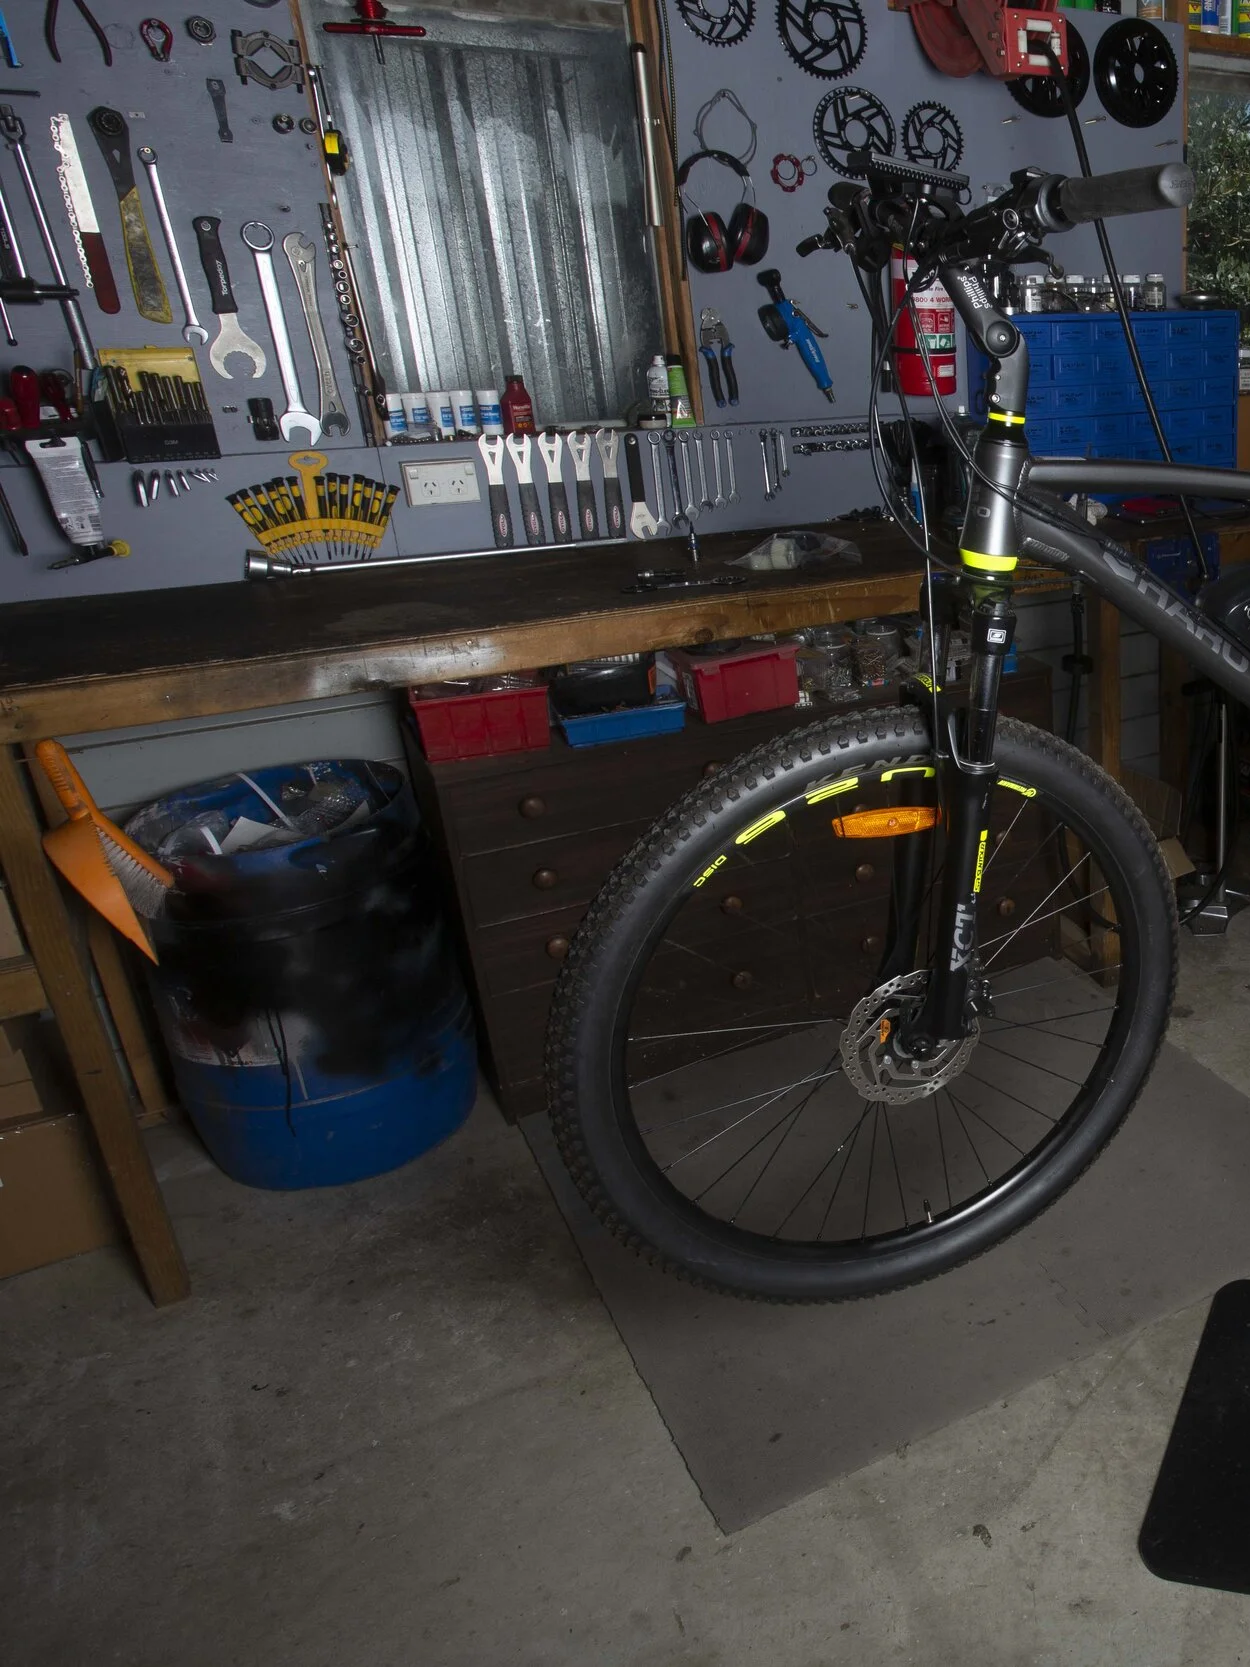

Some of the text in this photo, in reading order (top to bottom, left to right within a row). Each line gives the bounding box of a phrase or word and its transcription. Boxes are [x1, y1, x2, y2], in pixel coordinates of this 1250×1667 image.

[215, 259, 229, 296] Torpedo7
[960, 275, 983, 309] Phillips
[968, 275, 991, 309] Phillips
[804, 753, 933, 792] KEND
[692, 854, 728, 888] DISC
[949, 903, 976, 972] XCT
